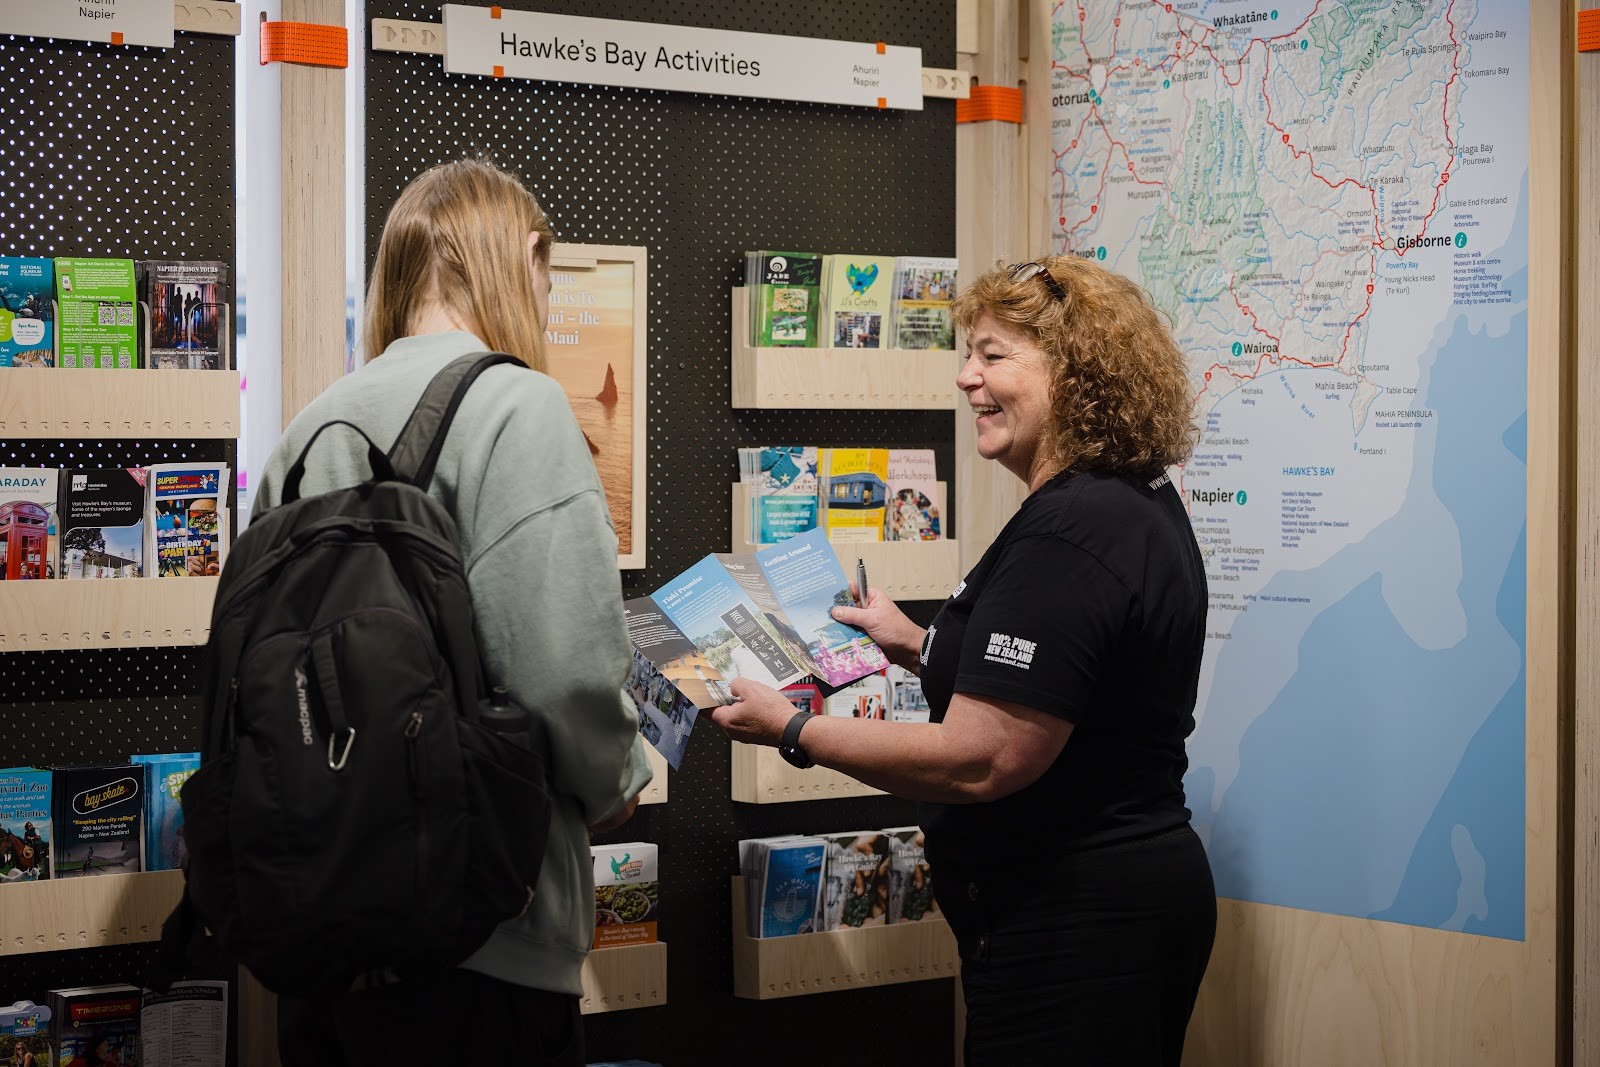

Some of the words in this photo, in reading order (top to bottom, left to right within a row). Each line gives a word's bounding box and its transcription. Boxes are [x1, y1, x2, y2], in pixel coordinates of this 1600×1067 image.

[79, 6, 116, 20] Napier
[1468, 32, 1494, 42] Waipiro
[1496, 30, 1507, 39] Bay
[501, 32, 596, 62] Hawke's
[605, 42, 646, 72] Bay
[654, 46, 760, 76] Activities
[1402, 48, 1410, 56] Te
[1428, 44, 1455, 54] Springs
[852, 64, 879, 76] Ahuriri
[1464, 70, 1496, 79] Tokomaru
[1498, 67, 1510, 76] Bay
[854, 76, 880, 88] Napier
[1172, 71, 1208, 83] Kawerau
[1313, 144, 1337, 152] Matawai
[1454, 144, 1477, 156] Tolaga
[1479, 143, 1494, 154] Bay
[1370, 177, 1378, 185] Te
[1380, 175, 1404, 185] Karaka
[1128, 190, 1160, 200] Murupara
[1480, 196, 1508, 205] Foreland
[1347, 209, 1372, 218] Ormond
[1397, 235, 1451, 248] Gisborne
[1316, 281, 1344, 289] Waingake
[1384, 276, 1401, 284] Young
[564, 290, 576, 304] is
[578, 291, 596, 305] Te
[854, 297, 878, 306] Crafts
[579, 311, 600, 325] the
[1244, 342, 1278, 354] Wairoa
[1280, 373, 1296, 399] Wairoa
[1300, 404, 1316, 419] River
[1283, 466, 1318, 476] HAWKE'S
[1320, 467, 1335, 476] BAY
[1192, 488, 1234, 506] Napier
[164, 547, 204, 557] PARTY'S
[764, 554, 788, 567] Getting
[788, 544, 812, 557] Around
[662, 590, 678, 604] Tiaki
[679, 576, 703, 593] Promise
[989, 633, 1011, 648] 100%
[1011, 637, 1037, 654] PURE
[986, 644, 1002, 656] NEW
[1000, 646, 1033, 664] ZEALAND
[984, 654, 1030, 670] newzealand.com
[76, 1003, 132, 1016] TIMEZONE
